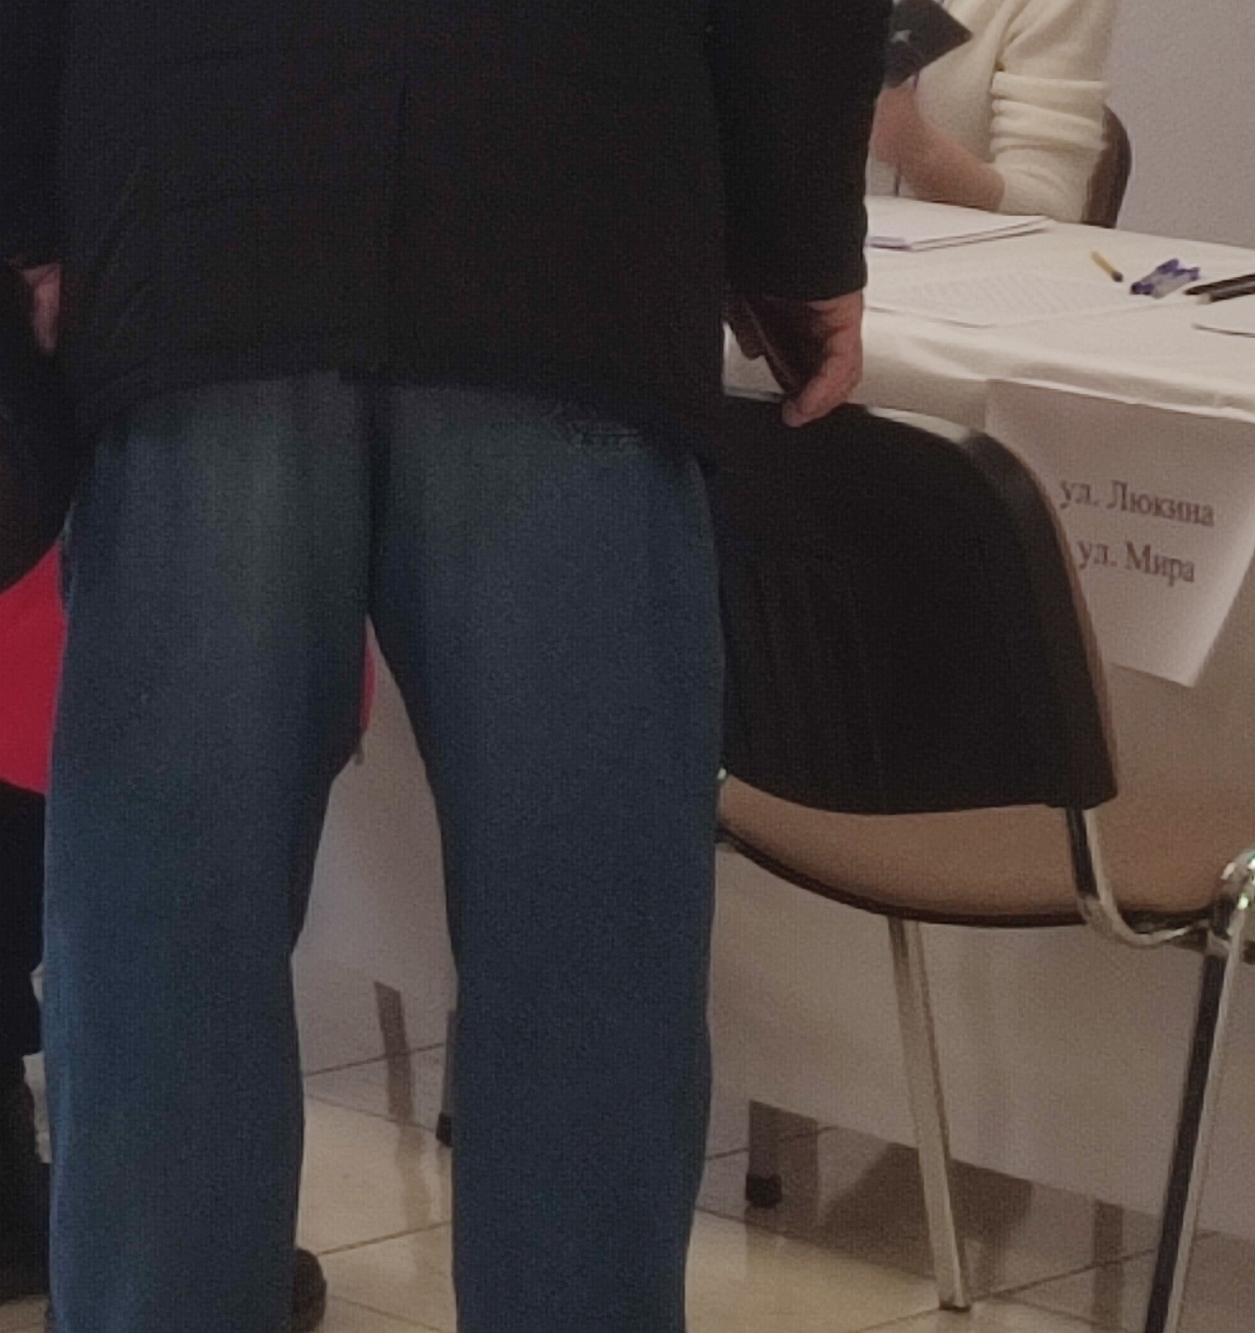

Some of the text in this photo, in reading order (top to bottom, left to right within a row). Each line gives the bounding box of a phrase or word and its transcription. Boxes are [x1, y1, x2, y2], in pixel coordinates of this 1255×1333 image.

[1059, 480, 1215, 527] ул. Люкина
[1077, 540, 1195, 587] ул. Мира
